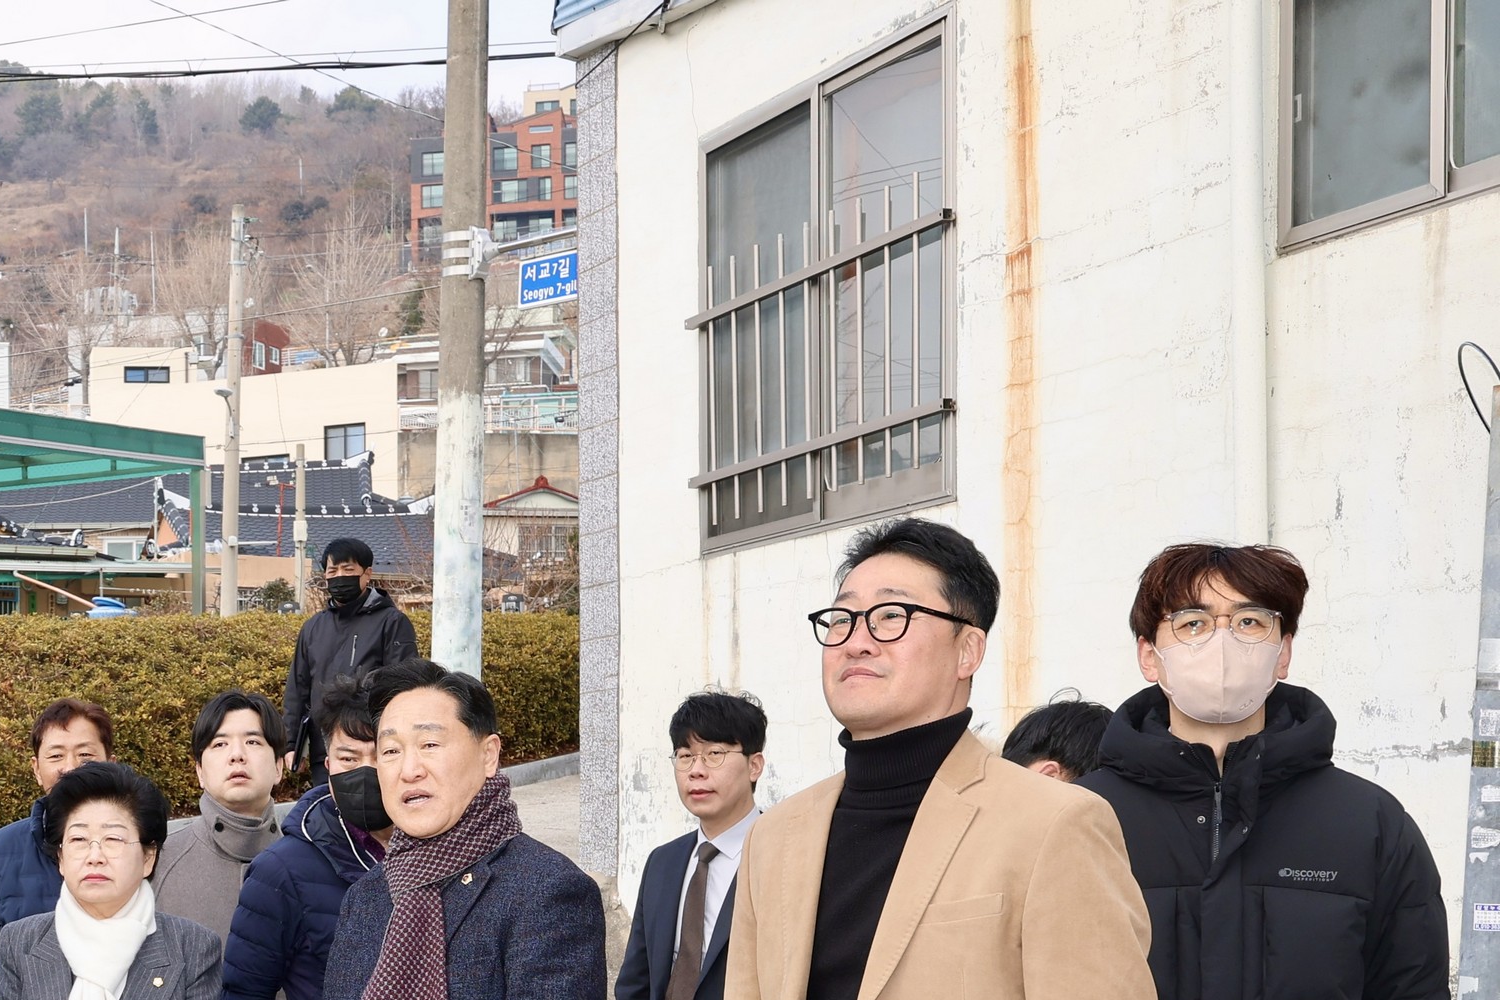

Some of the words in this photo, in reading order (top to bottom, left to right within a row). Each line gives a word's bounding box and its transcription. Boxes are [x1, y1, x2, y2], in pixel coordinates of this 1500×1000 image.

[524, 257, 570, 282] 서교7길
[523, 286, 554, 302] Seogyo
[556, 279, 577, 295] 7-gil
